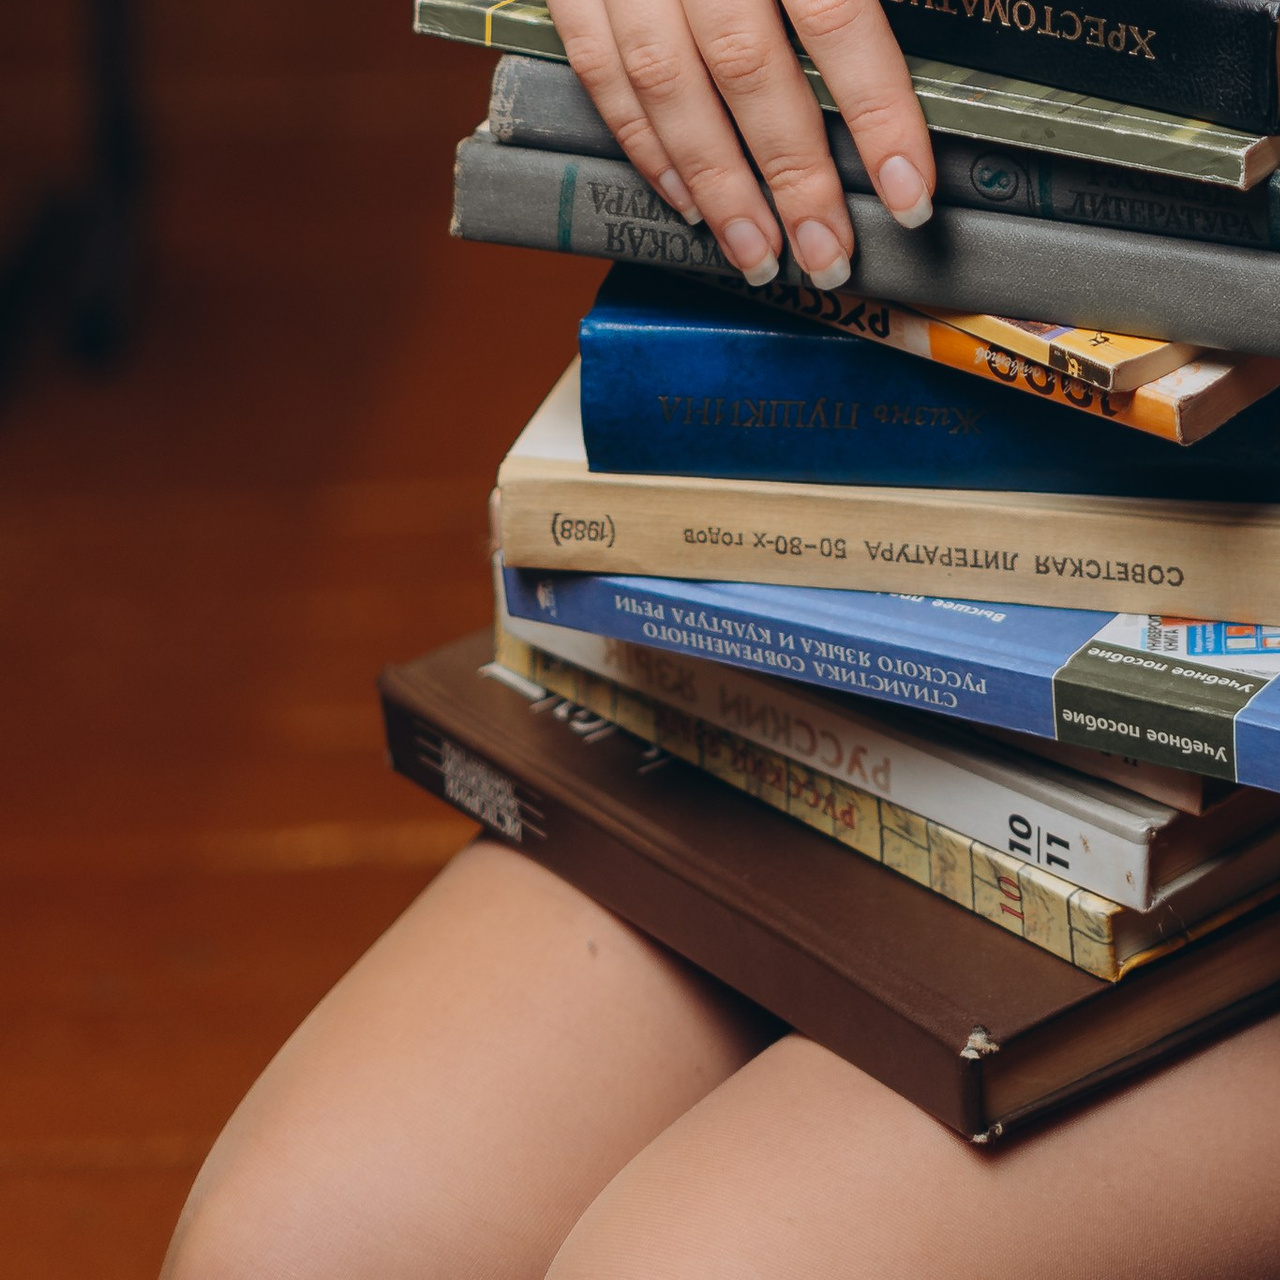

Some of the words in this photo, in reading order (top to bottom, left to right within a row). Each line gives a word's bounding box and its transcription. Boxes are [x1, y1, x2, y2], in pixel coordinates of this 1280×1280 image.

[1063, 191, 1261, 239] ЛИТЕРАТУРА
[604, 221, 724, 269] УССКАЯ
[657, 395, 861, 431] ПУШКИНА
[871, 403, 987, 437] Жизнь
[551, 512, 616, 549] (1988)
[683, 527, 744, 547] годов
[863, 540, 1019, 574] ЛИТЕРАТУРА
[1034, 554, 1185, 588] СОВЕТСКАЯ
[614, 594, 665, 620] РЕЧИ
[931, 598, 1007, 623] Высшее
[670, 606, 771, 646] КУЛЬТУРА
[777, 631, 796, 651] И
[642, 621, 806, 673] СОВРЕМЕННОГО
[800, 636, 872, 667] ЯЗЫКА
[1087, 646, 1168, 673] пособие
[813, 660, 958, 708] СТИЛИСТИКА
[877, 655, 988, 695] РУССКОГО
[1173, 666, 1254, 693] Учебное
[1062, 708, 1141, 739] пособие
[1146, 728, 1228, 763] Учебное
[1008, 813, 1032, 856] 10
[1046, 832, 1070, 870] 11
[997, 876, 1025, 921] 10
